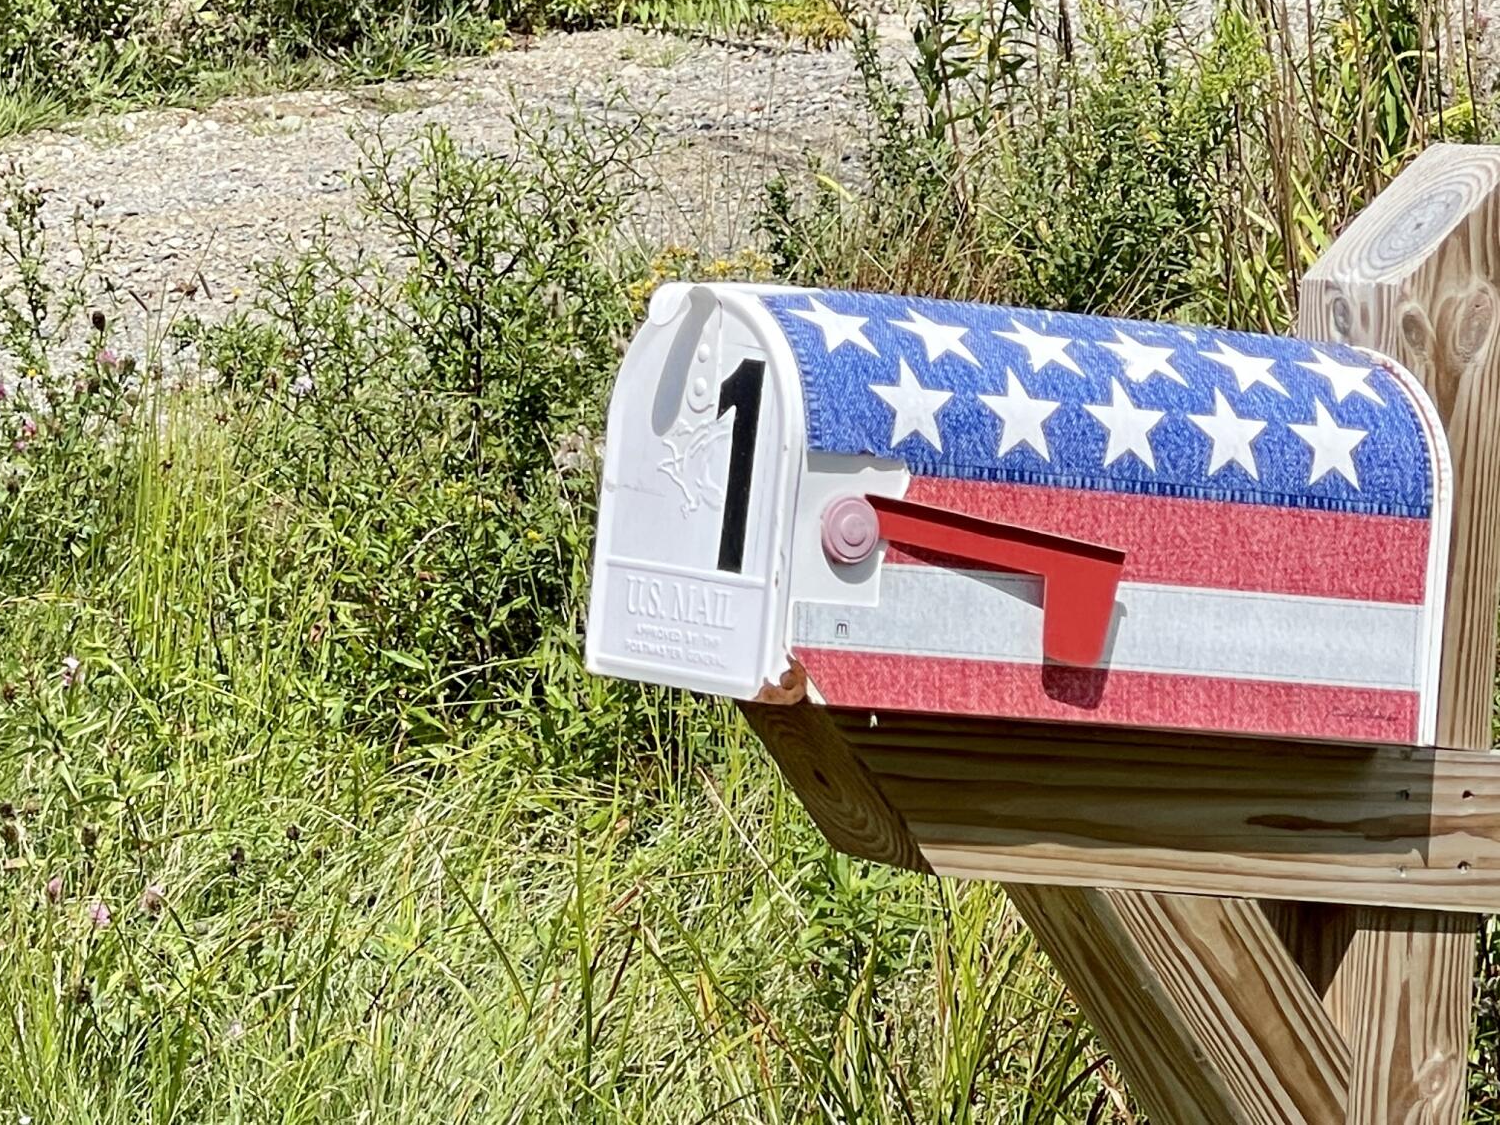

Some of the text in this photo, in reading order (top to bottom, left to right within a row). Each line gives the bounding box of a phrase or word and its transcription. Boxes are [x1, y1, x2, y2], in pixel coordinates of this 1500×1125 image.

[716, 358, 766, 574] 1
[626, 575, 736, 632] U.S. MAIL
